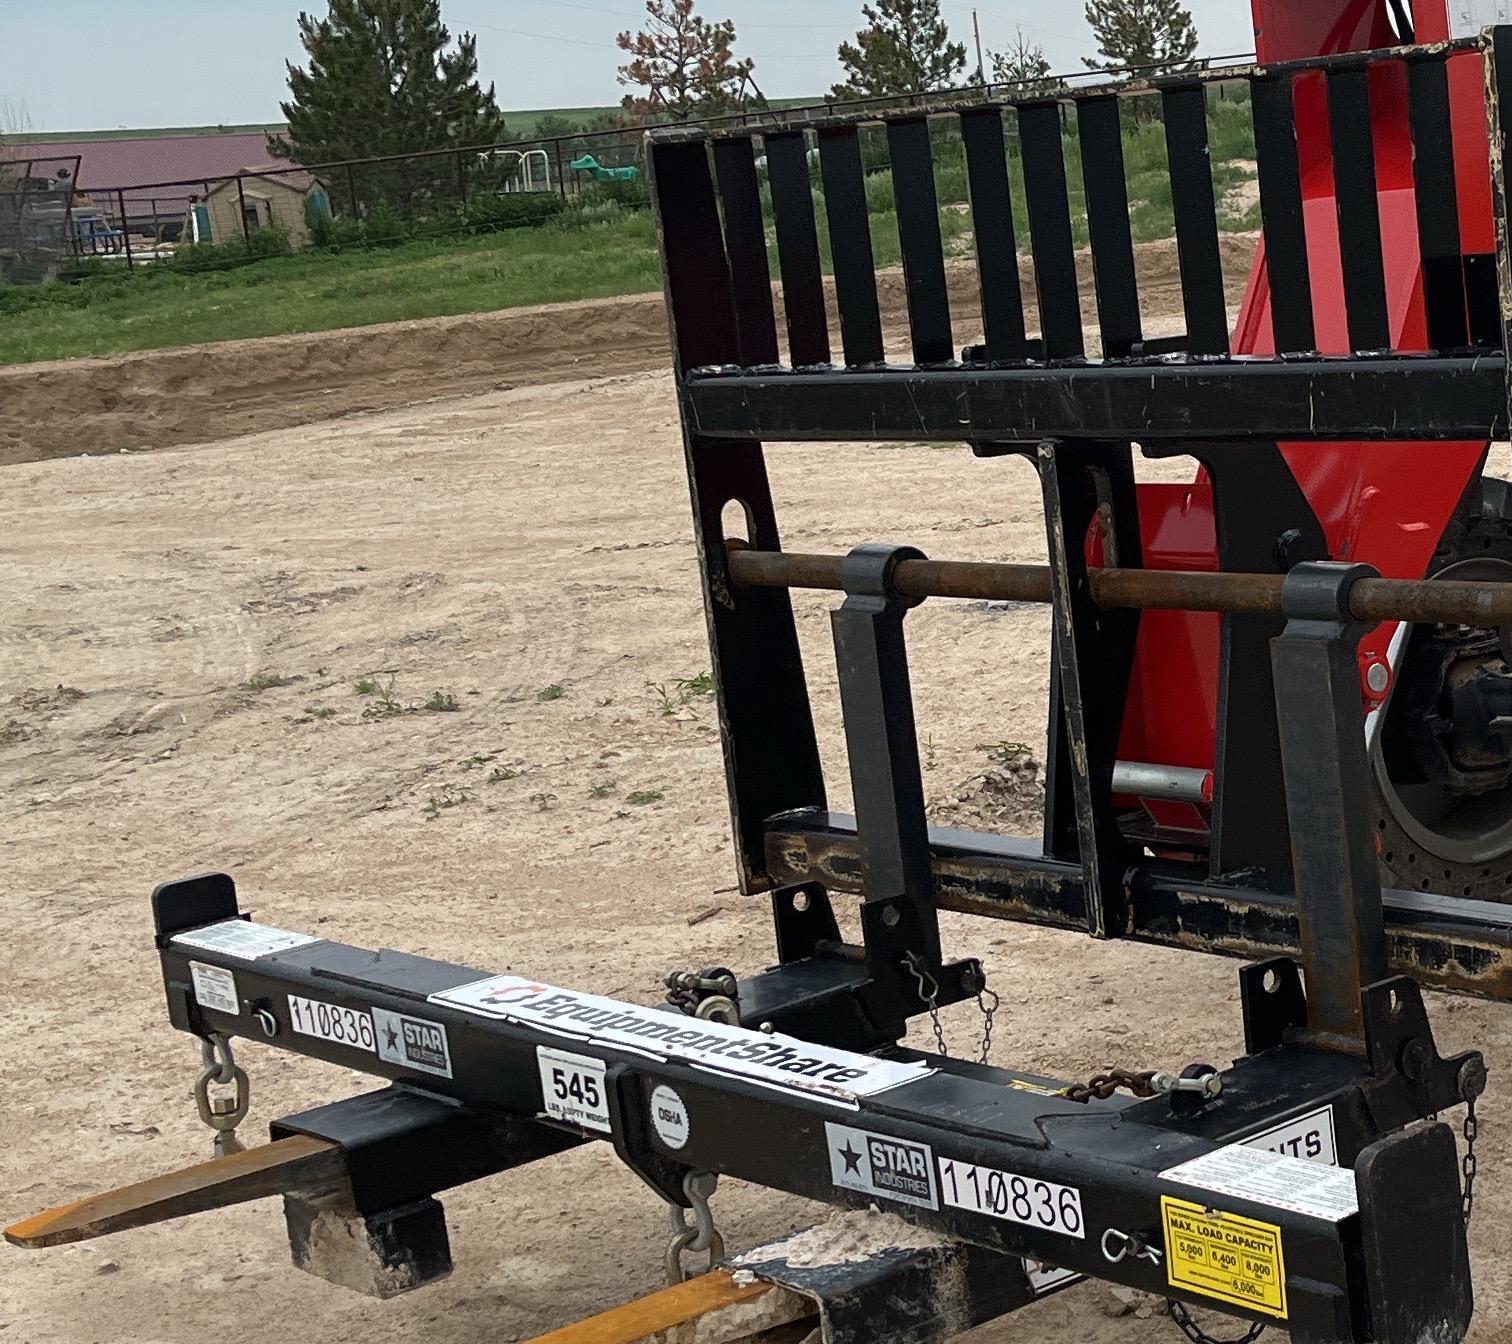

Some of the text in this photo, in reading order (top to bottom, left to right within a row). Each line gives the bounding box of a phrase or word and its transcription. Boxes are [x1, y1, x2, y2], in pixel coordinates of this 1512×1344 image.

[292, 996, 373, 1048] 110836
[404, 1022, 443, 1052] STAR
[523, 992, 868, 1084] EquipmentShare
[552, 1067, 600, 1108] 545
[658, 1106, 683, 1127] OSHA
[869, 1140, 927, 1179] STAR
[873, 1170, 929, 1195] INDUSTRIES
[944, 1160, 1080, 1233] 110836
[1170, 1218, 1195, 1234] MAX.
[1197, 1224, 1223, 1240] LOAD
[1225, 1232, 1274, 1255] CAPACITY
